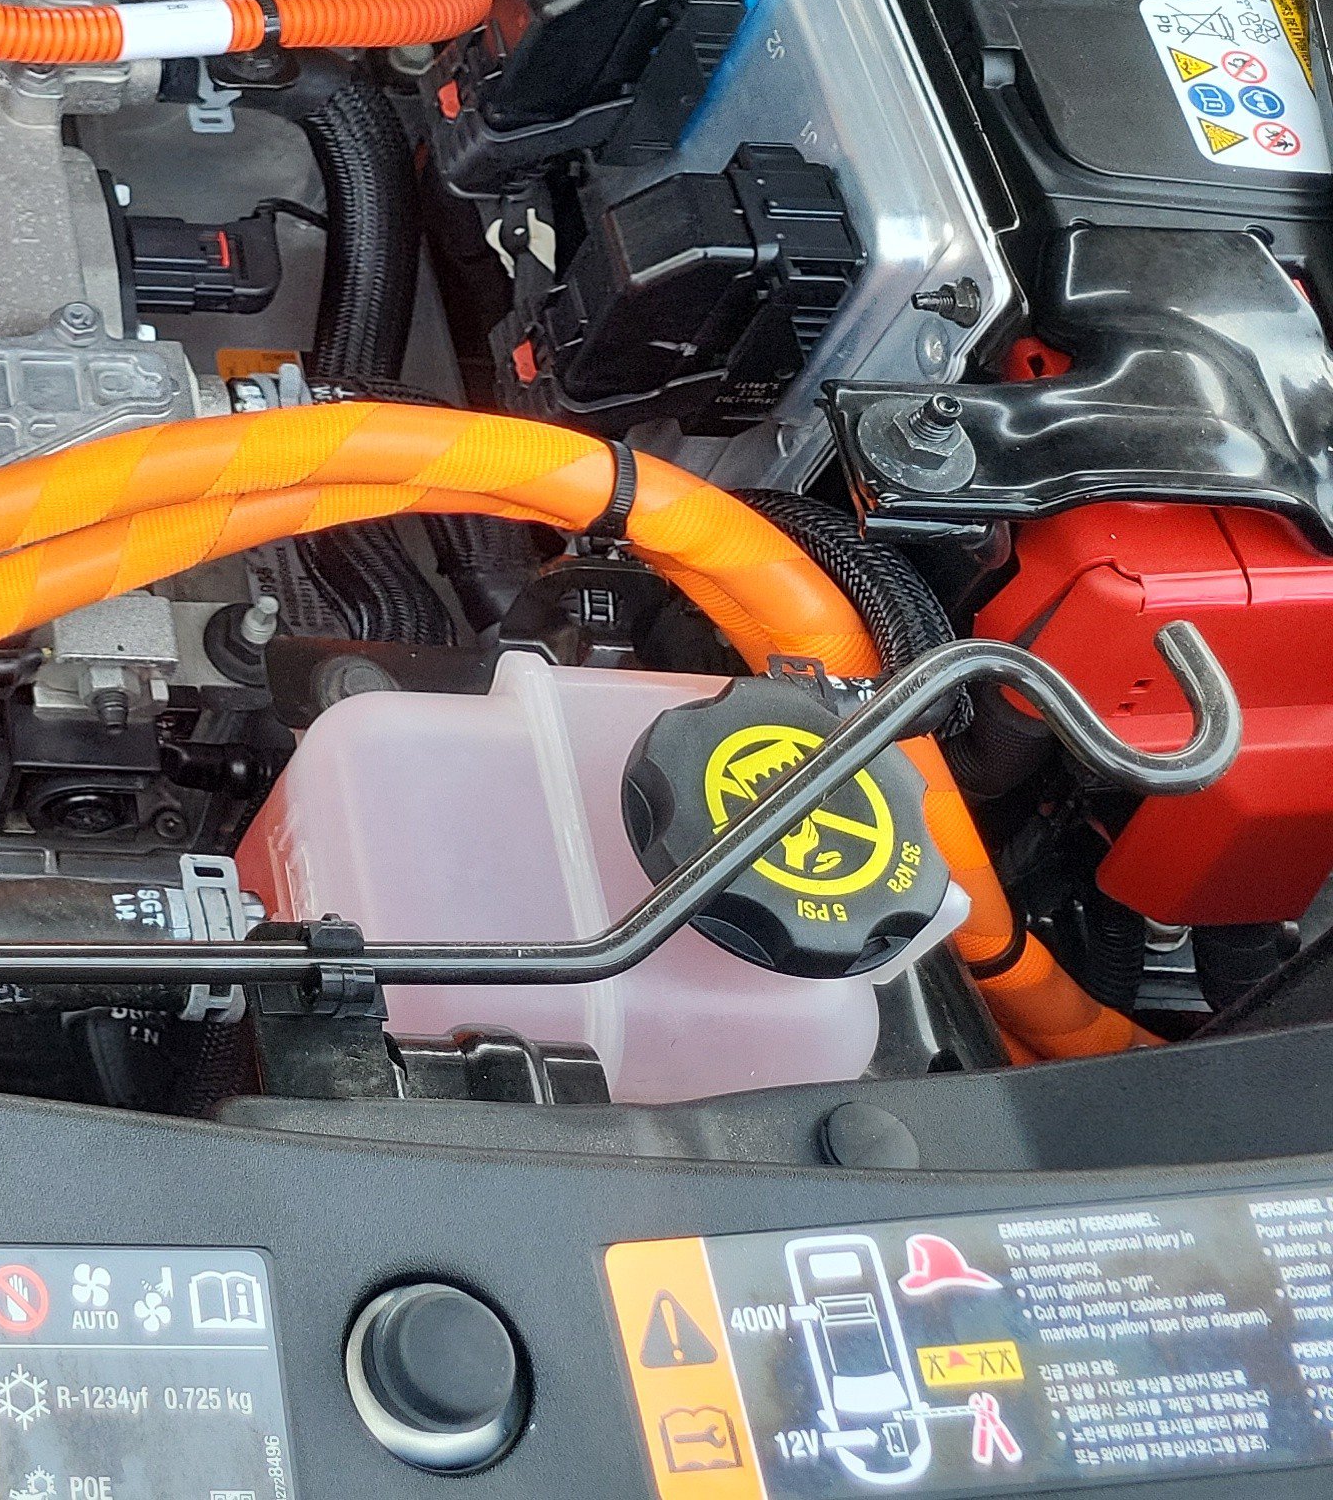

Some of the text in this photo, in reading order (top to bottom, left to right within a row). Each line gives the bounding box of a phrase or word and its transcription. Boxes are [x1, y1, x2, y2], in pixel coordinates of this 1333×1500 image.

[1153, 14, 1173, 33] Pb
[886, 841, 922, 893] 35 kPa
[796, 899, 848, 922] 5 PSI
[997, 1211, 1161, 1241] EMERGENCY PERSONNEL:
[1255, 1219, 1323, 1240] Pour éviter
[1003, 1230, 1195, 1261] To help avoid personal injury in
[1273, 1241, 1319, 1260] Mettez
[1009, 1265, 1029, 1282] an
[1279, 1261, 1332, 1282] position
[1026, 1279, 1123, 1302] Turn ignition to
[1286, 1283, 1332, 1301] Couper
[1032, 1291, 1227, 1321] Cut any battery cables or wires
[71, 1309, 120, 1331] AUTO
[730, 1303, 787, 1334] 400V
[1039, 1322, 1090, 1344] marked
[1090, 1322, 1108, 1341] by
[1107, 1317, 1150, 1338] yellow
[1149, 1316, 1181, 1335] tape
[1181, 1313, 1211, 1333] (see
[1298, 1363, 1332, 1381] Para
[56, 1386, 253, 1414] R-1234yf 0.725 kg
[773, 1428, 819, 1460] 12V
[70, 1476, 113, 1500] POE
